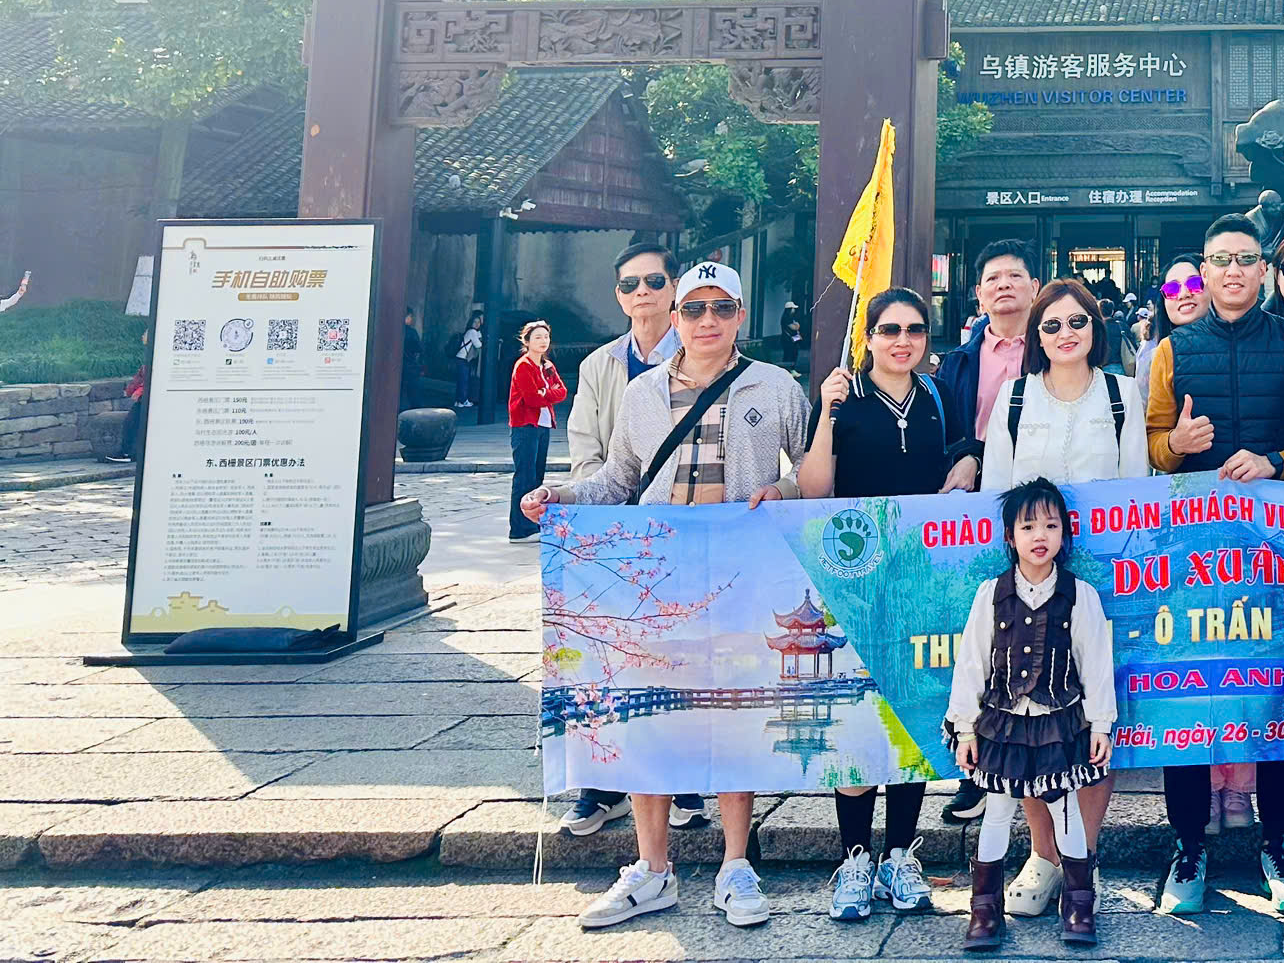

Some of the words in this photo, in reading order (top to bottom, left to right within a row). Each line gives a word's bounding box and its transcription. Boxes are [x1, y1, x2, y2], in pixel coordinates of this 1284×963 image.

[979, 51, 1187, 80] 乌镇游客服务中心
[1042, 90, 1113, 105] VISITOR
[1119, 88, 1188, 103] CENTER
[985, 191, 1041, 206] 景区入口
[1041, 194, 1070, 203] Entrance
[1088, 189, 1143, 204] 住宿办理
[1145, 189, 1198, 197] Accommodation
[211, 269, 328, 289] 手机自助购票
[698, 264, 717, 279] NY
[205, 458, 305, 468] 东、西栅景区门票优惠办法
[923, 513, 993, 548] CHÀO
[1090, 499, 1161, 536] ĐOÀN
[1170, 490, 1255, 527] KHÁCH
[1111, 548, 1171, 597] DU
[1154, 604, 1174, 645] Ô
[1186, 596, 1273, 643] TRẤN
[1129, 669, 1208, 693] HOA
[1115, 722, 1156, 749] Hải,
[1163, 721, 1218, 750] ngày
[1220, 721, 1249, 743] 26
